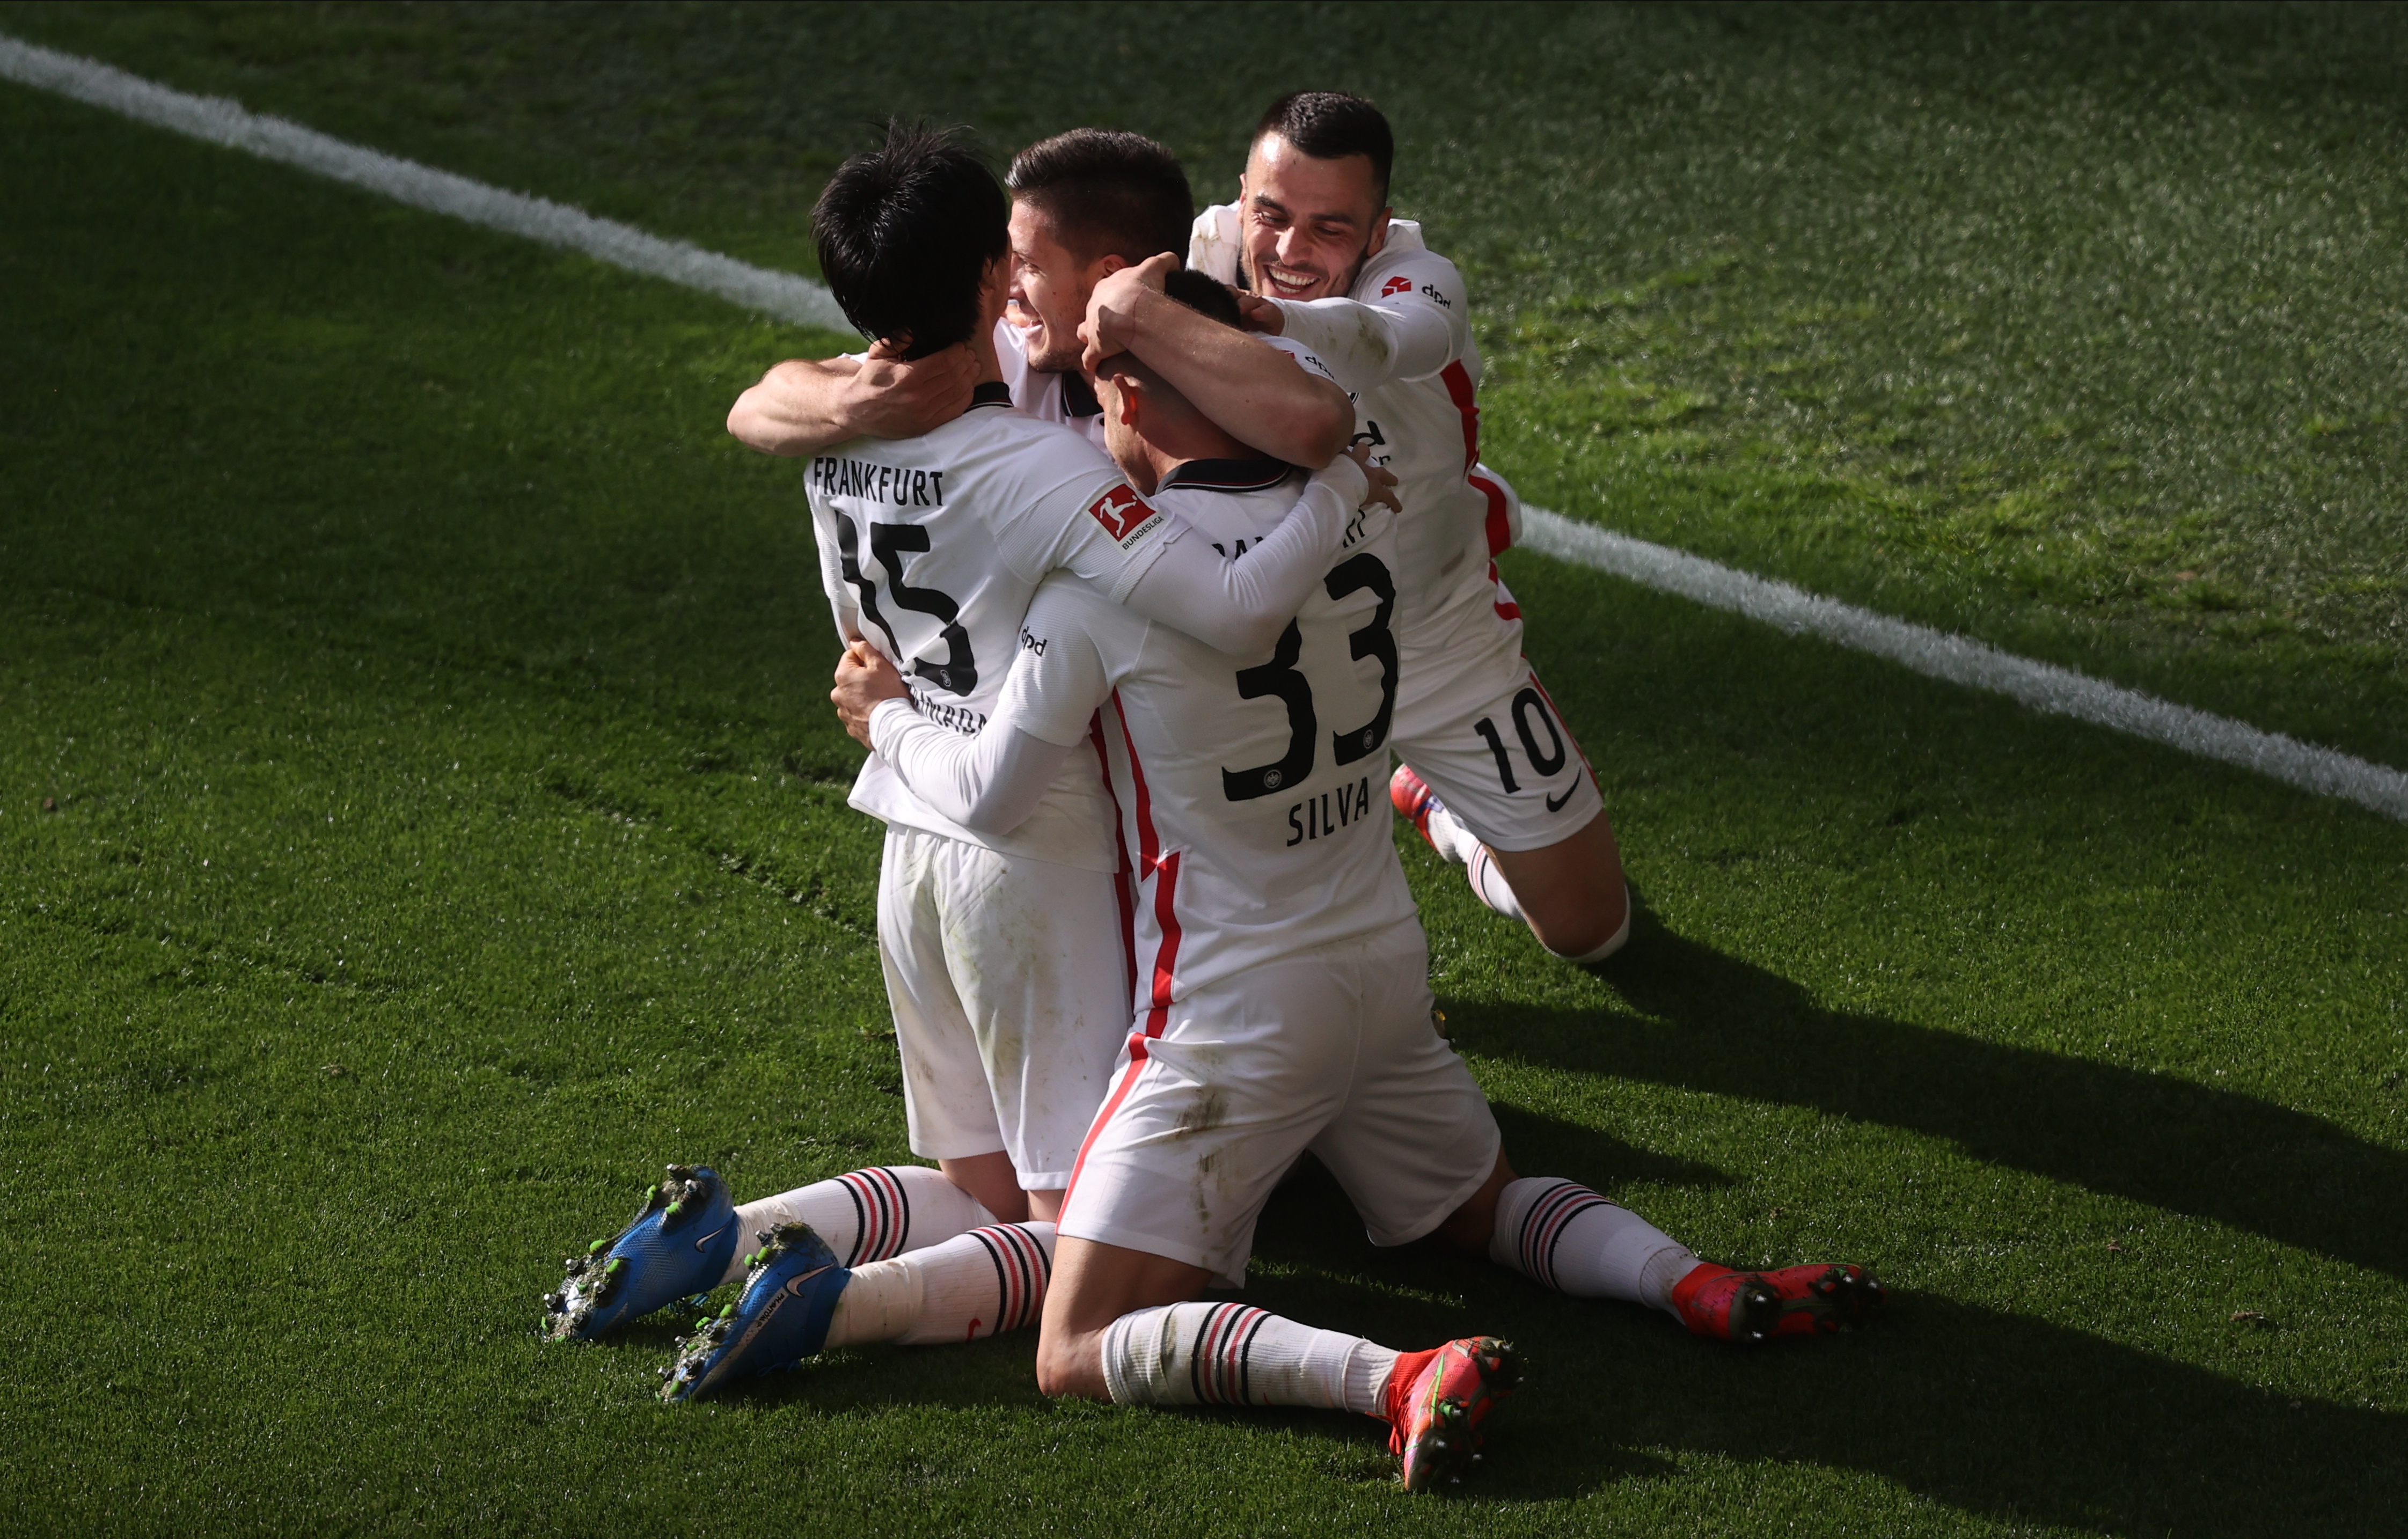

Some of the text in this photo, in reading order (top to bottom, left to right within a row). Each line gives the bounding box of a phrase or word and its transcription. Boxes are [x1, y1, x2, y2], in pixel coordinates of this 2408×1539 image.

[1305, 356, 1334, 379] dp
[814, 457, 943, 505] FRANKFURT
[1122, 516, 1164, 550] BUNDESLIGA
[835, 510, 978, 697] 15
[1021, 626, 1048, 657] dpd
[1221, 553, 1399, 801] 33
[1474, 687, 1565, 794] 10
[1287, 776, 1368, 846] SILVA
